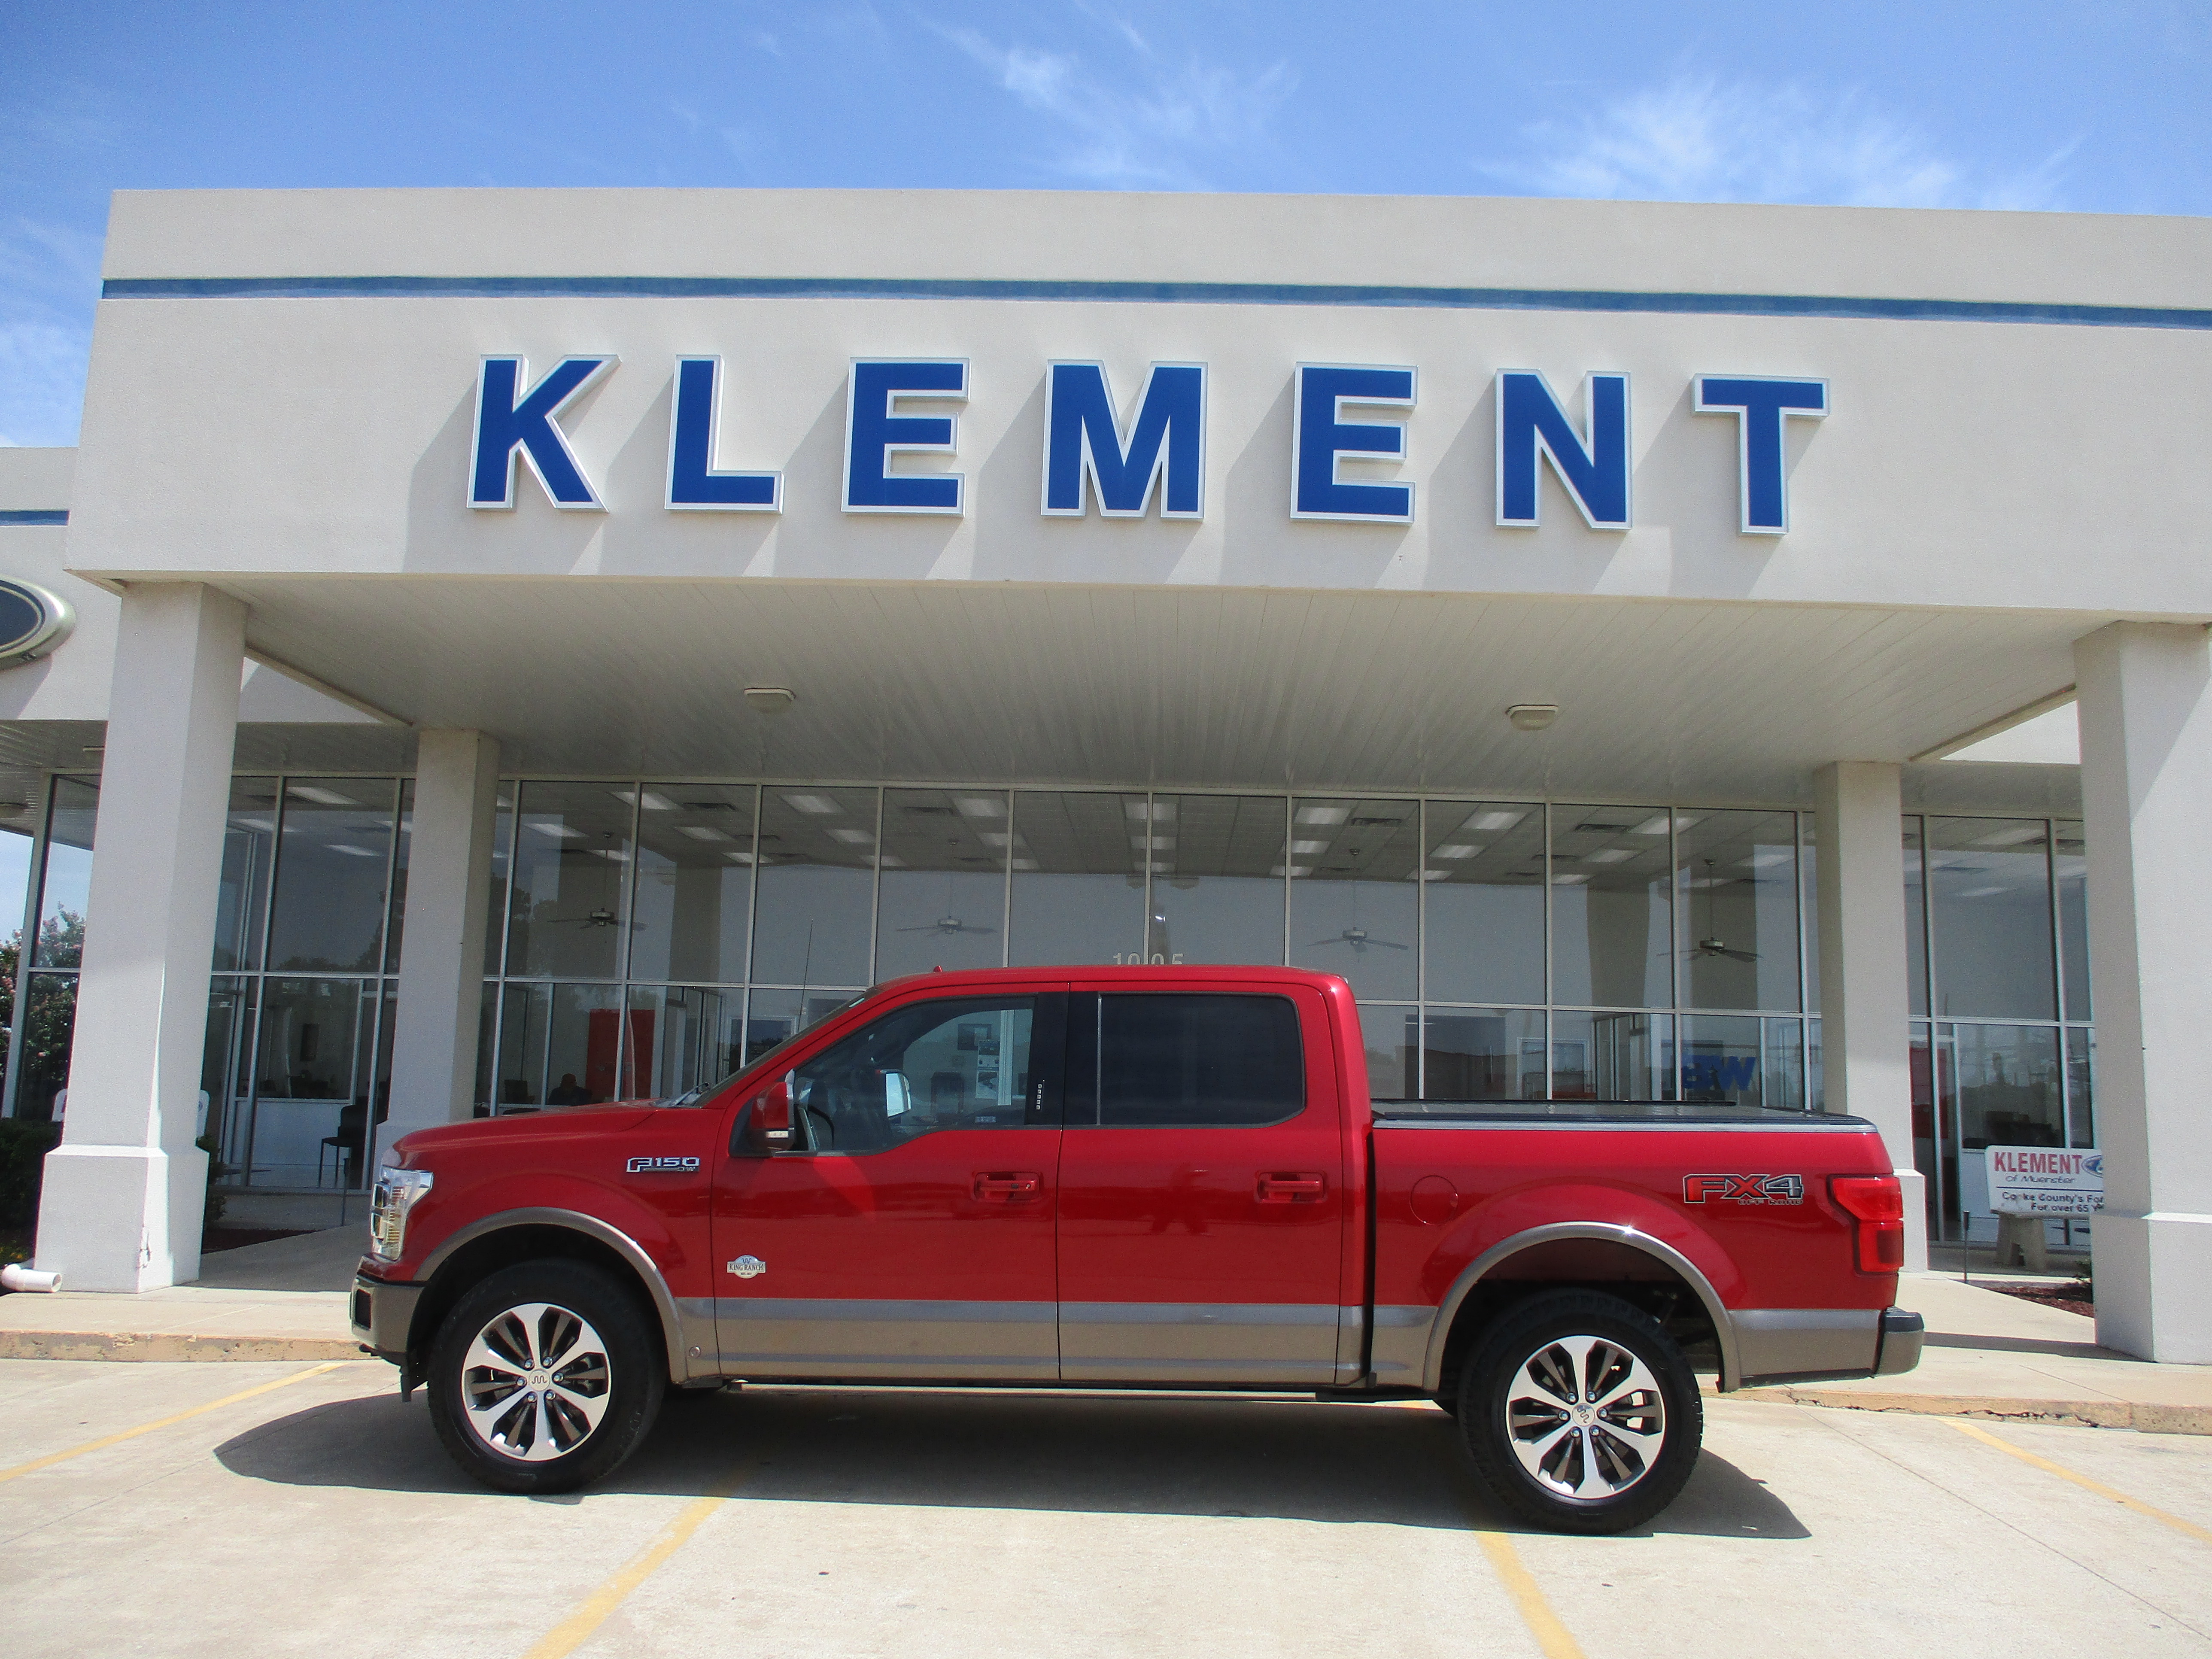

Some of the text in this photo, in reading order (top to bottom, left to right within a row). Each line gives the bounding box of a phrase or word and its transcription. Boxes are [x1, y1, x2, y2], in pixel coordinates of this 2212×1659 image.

[467, 354, 1830, 535] KLEMENT
[1994, 1152, 2082, 1174] KLEMENT
[1683, 1173, 1804, 1203] FX4
[2021, 1176, 2075, 1184] Muenster
[2002, 1191, 2035, 1200] Coke
[2037, 1194, 2084, 1204] County's
[2076, 1204, 2089, 1212] 65
